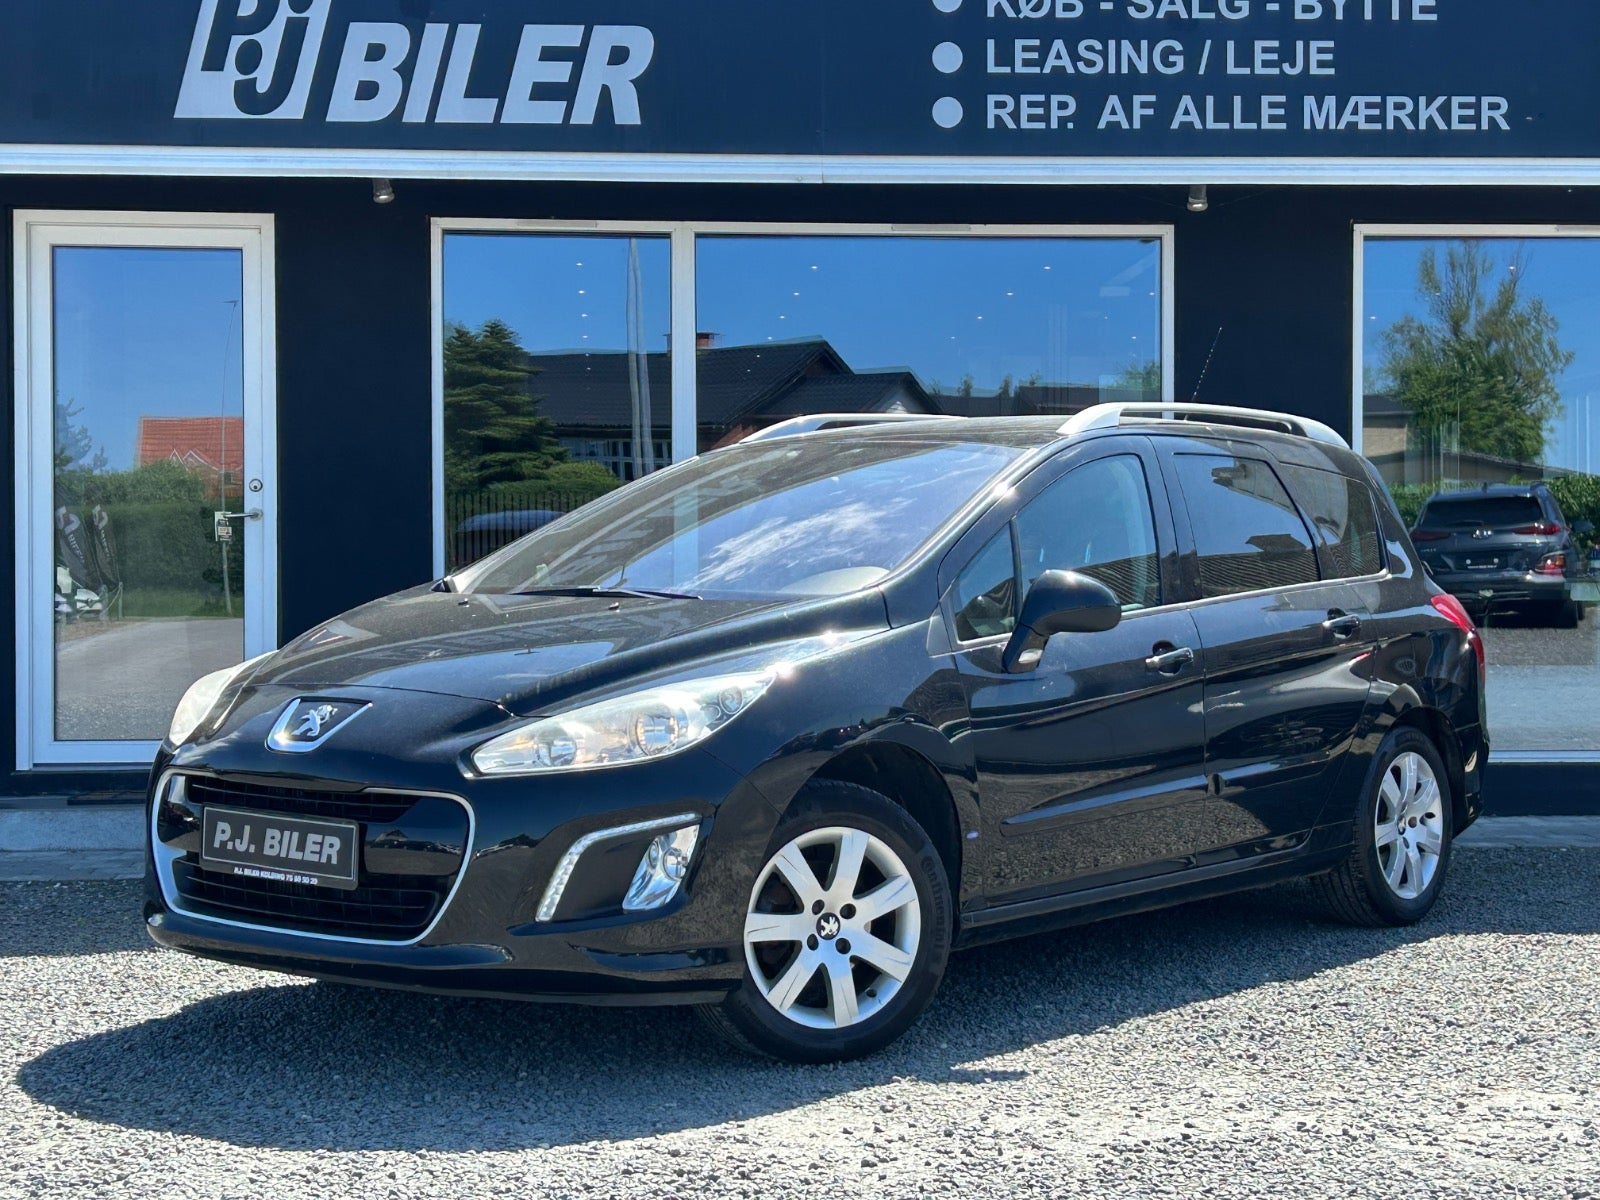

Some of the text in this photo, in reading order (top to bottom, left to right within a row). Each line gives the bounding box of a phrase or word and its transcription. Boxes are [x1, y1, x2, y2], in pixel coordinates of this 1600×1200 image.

[326, 22, 654, 125] BILER
[987, 39, 1184, 75] LEASING
[1227, 40, 1336, 75] LEJE
[987, 95, 1511, 131] REP. AF ALLE MÆRKER
[213, 821, 341, 865] P.J. BILER
